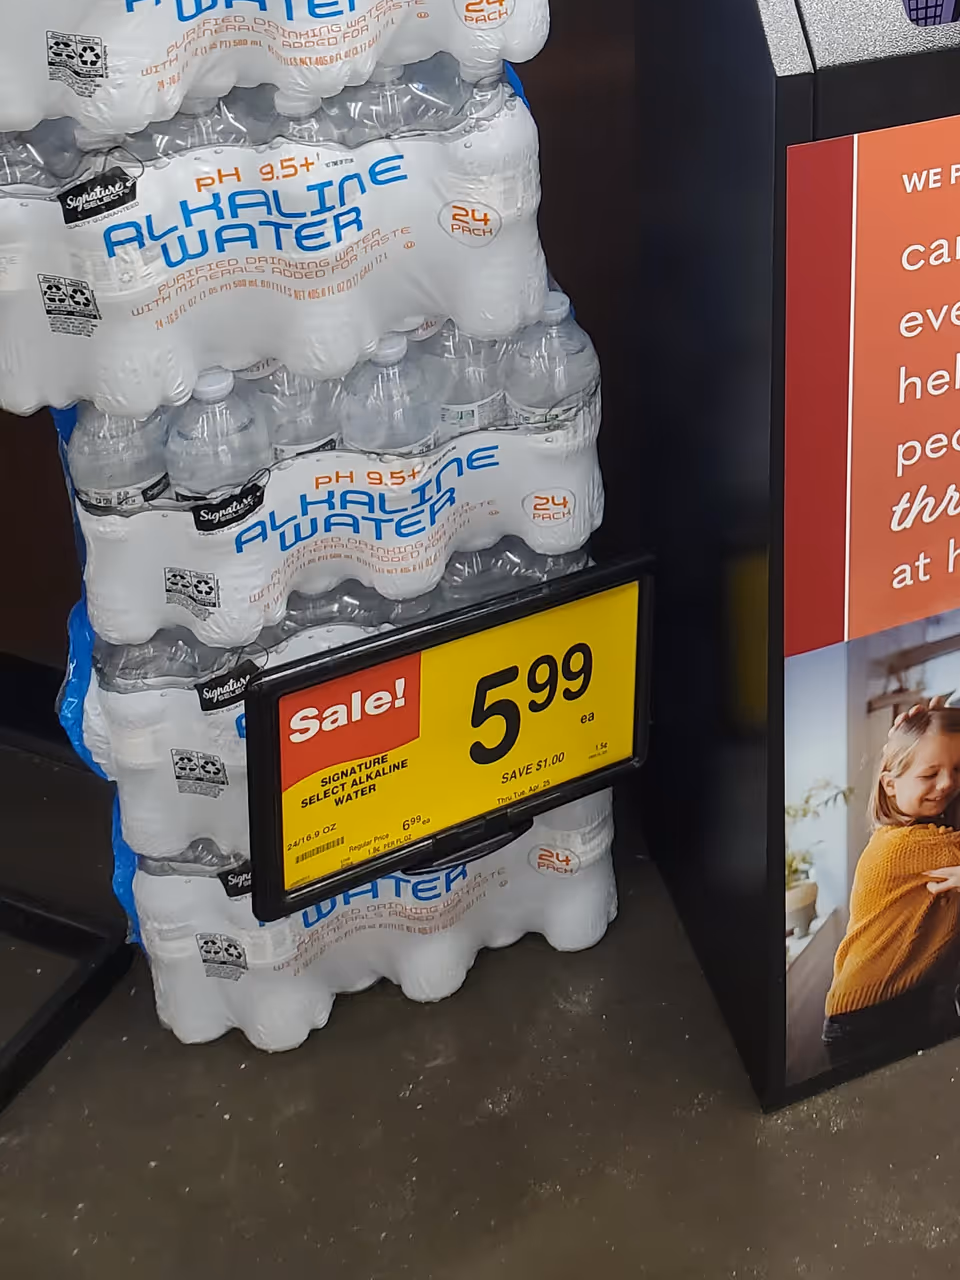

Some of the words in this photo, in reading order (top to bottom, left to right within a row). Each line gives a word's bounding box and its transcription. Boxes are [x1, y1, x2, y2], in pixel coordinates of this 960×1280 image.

[463, 9, 509, 24] PACK
[66, 181, 125, 212] Signature
[901, 167, 942, 194] WE
[103, 154, 408, 259] ALKALINE
[160, 206, 363, 269] WATER
[234, 445, 500, 554] ALKALINE
[279, 486, 456, 552] WATER
[891, 552, 932, 590] at
[289, 677, 407, 743] Sale!
[580, 711, 595, 725] ea
[300, 783, 347, 809] SELECT
[350, 758, 409, 788] ALKALINE
[320, 753, 389, 788] SIGNATURE
[501, 762, 534, 785] SAVE
[535, 751, 565, 772] $1.00
[334, 783, 377, 807] WATER
[287, 830, 321, 851] 24/16.9
[322, 823, 338, 834] OZ
[348, 838, 374, 853] Regular
[373, 833, 390, 844] Price
